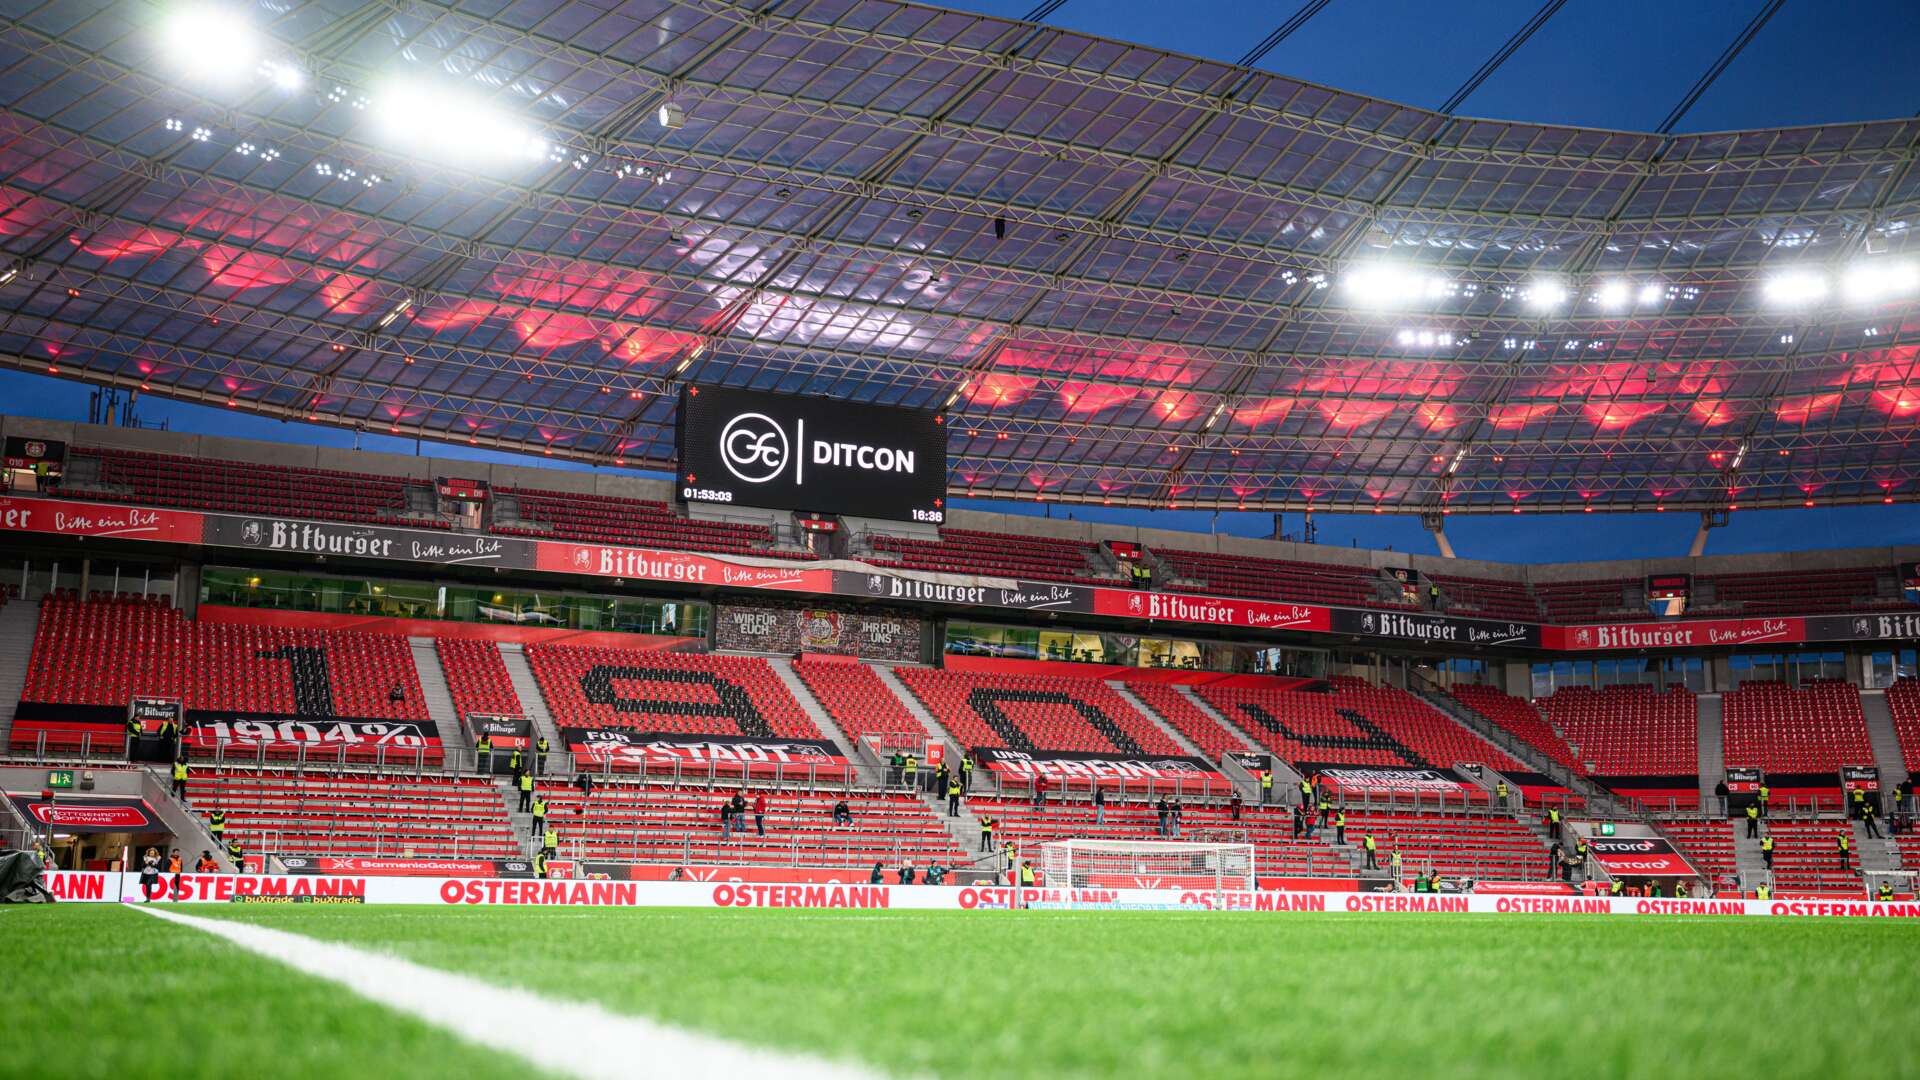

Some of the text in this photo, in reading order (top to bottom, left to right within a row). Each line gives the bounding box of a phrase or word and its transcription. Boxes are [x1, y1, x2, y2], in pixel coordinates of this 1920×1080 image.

[814, 440, 914, 473] DITCON
[683, 487, 732, 501] 01:53:03
[0, 508, 159, 530] er Bitte ein Bit
[912, 509, 942, 521] 16:36
[269, 522, 502, 558] Bitburger Bitte ein Bit
[599, 548, 706, 581] Bitburger
[723, 567, 753, 583] Bitte
[755, 571, 778, 579] ein
[1001, 589, 1027, 604] Bitte
[1030, 593, 1049, 601] ein
[1050, 587, 1072, 599] Bit
[1148, 594, 1234, 623] Bitburger
[1247, 609, 1271, 624] Bitte
[1273, 613, 1291, 621] ein
[1292, 606, 1311, 617] Bit
[733, 612, 776, 626] WIR FÜR
[740, 625, 769, 635] EUCH
[862, 621, 900, 634] IHR FÜR
[1380, 614, 1457, 640] Bitburger
[1469, 627, 1490, 641] Bitte
[1492, 630, 1508, 638] ein
[1509, 625, 1527, 636] Bit
[1598, 625, 1693, 647] Bitburger
[1710, 628, 1737, 643] Bitte
[1741, 628, 1761, 637] ein
[1763, 620, 1788, 633] Bit
[870, 633, 891, 643] UNS
[144, 706, 175, 717] Bitburger
[205, 719, 422, 746] 1904%
[490, 723, 516, 733] Bitburger
[515, 738, 525, 746] D4
[647, 741, 791, 763] STADT
[931, 750, 940, 758] D3
[992, 750, 1032, 760] UND
[1002, 759, 1161, 779] VEREIN
[53, 814, 112, 823] SOFTWARE
[361, 860, 482, 870] BarmeniaGothaer
[42, 874, 105, 900] ANN
[142, 875, 366, 901] OSTERMANN
[440, 880, 637, 905] OSTERMANN
[245, 895, 295, 904] buXtrade
[313, 895, 361, 904] buXtrade
[713, 884, 889, 908] OSTERMANN
[1346, 895, 1469, 912] OSTERMANN
[1496, 897, 1611, 913] OSTERMANN
[1637, 900, 1745, 914] OSTERMANN
[1771, 903, 1920, 917] OSTERMANN
